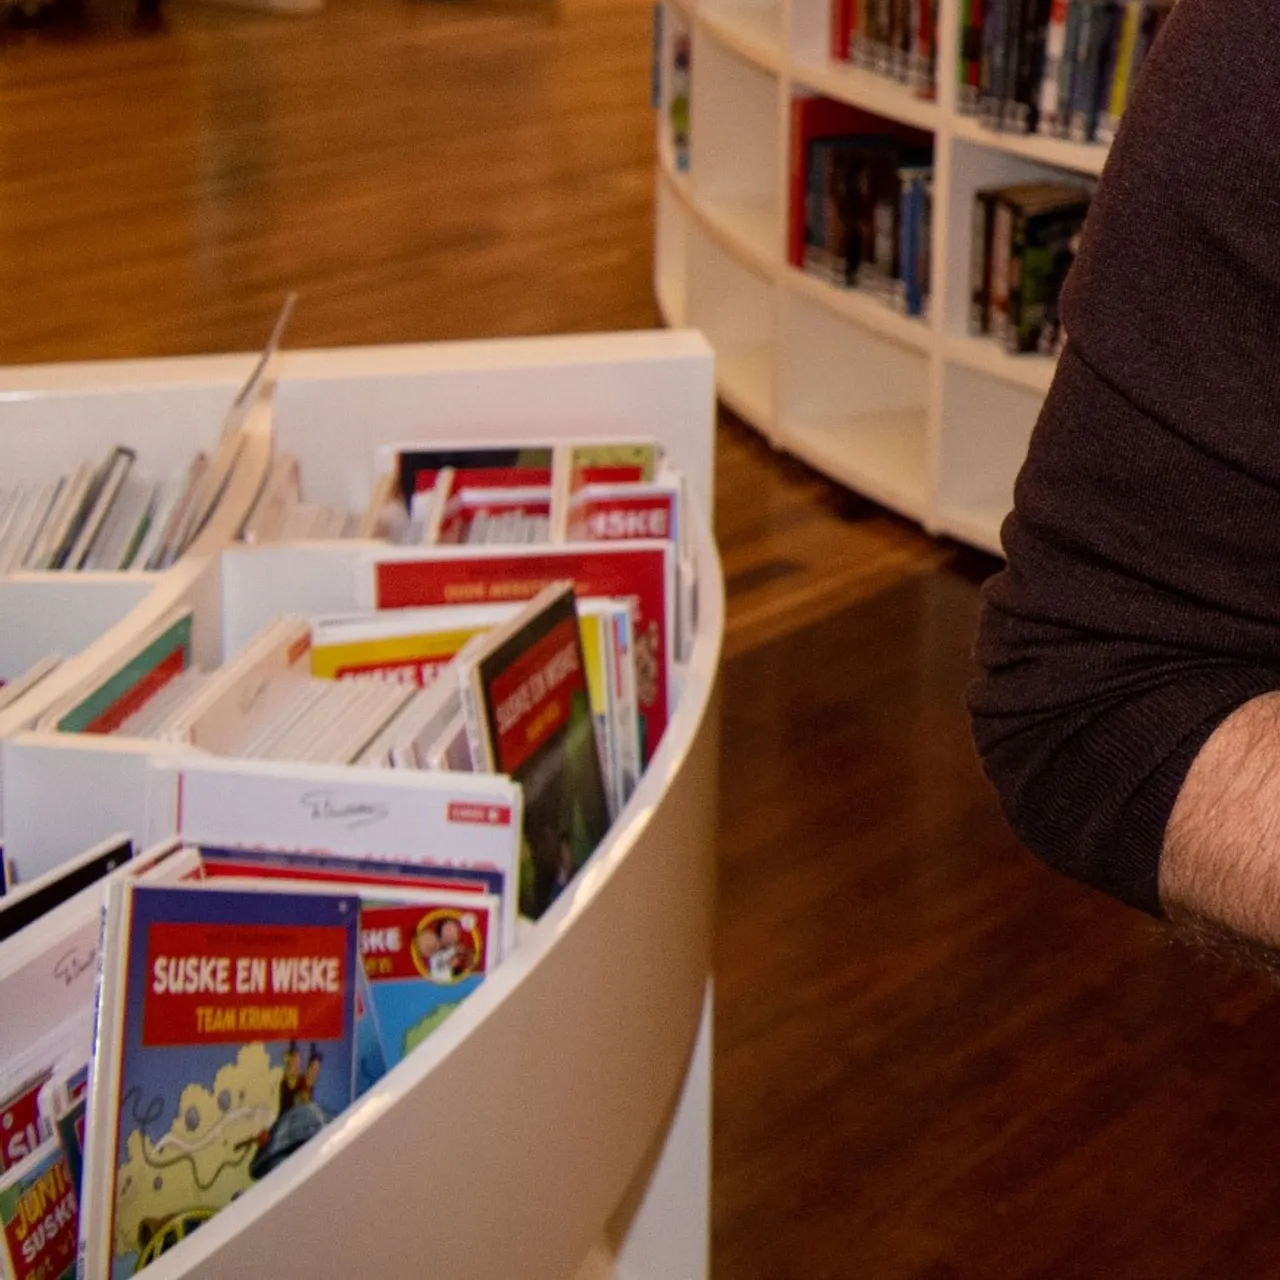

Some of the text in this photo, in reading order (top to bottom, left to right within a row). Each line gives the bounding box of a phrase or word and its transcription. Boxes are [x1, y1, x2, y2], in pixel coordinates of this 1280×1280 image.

[152, 955, 340, 995] SUSKE EN WISKE
[195, 1004, 236, 1034] TEAM
